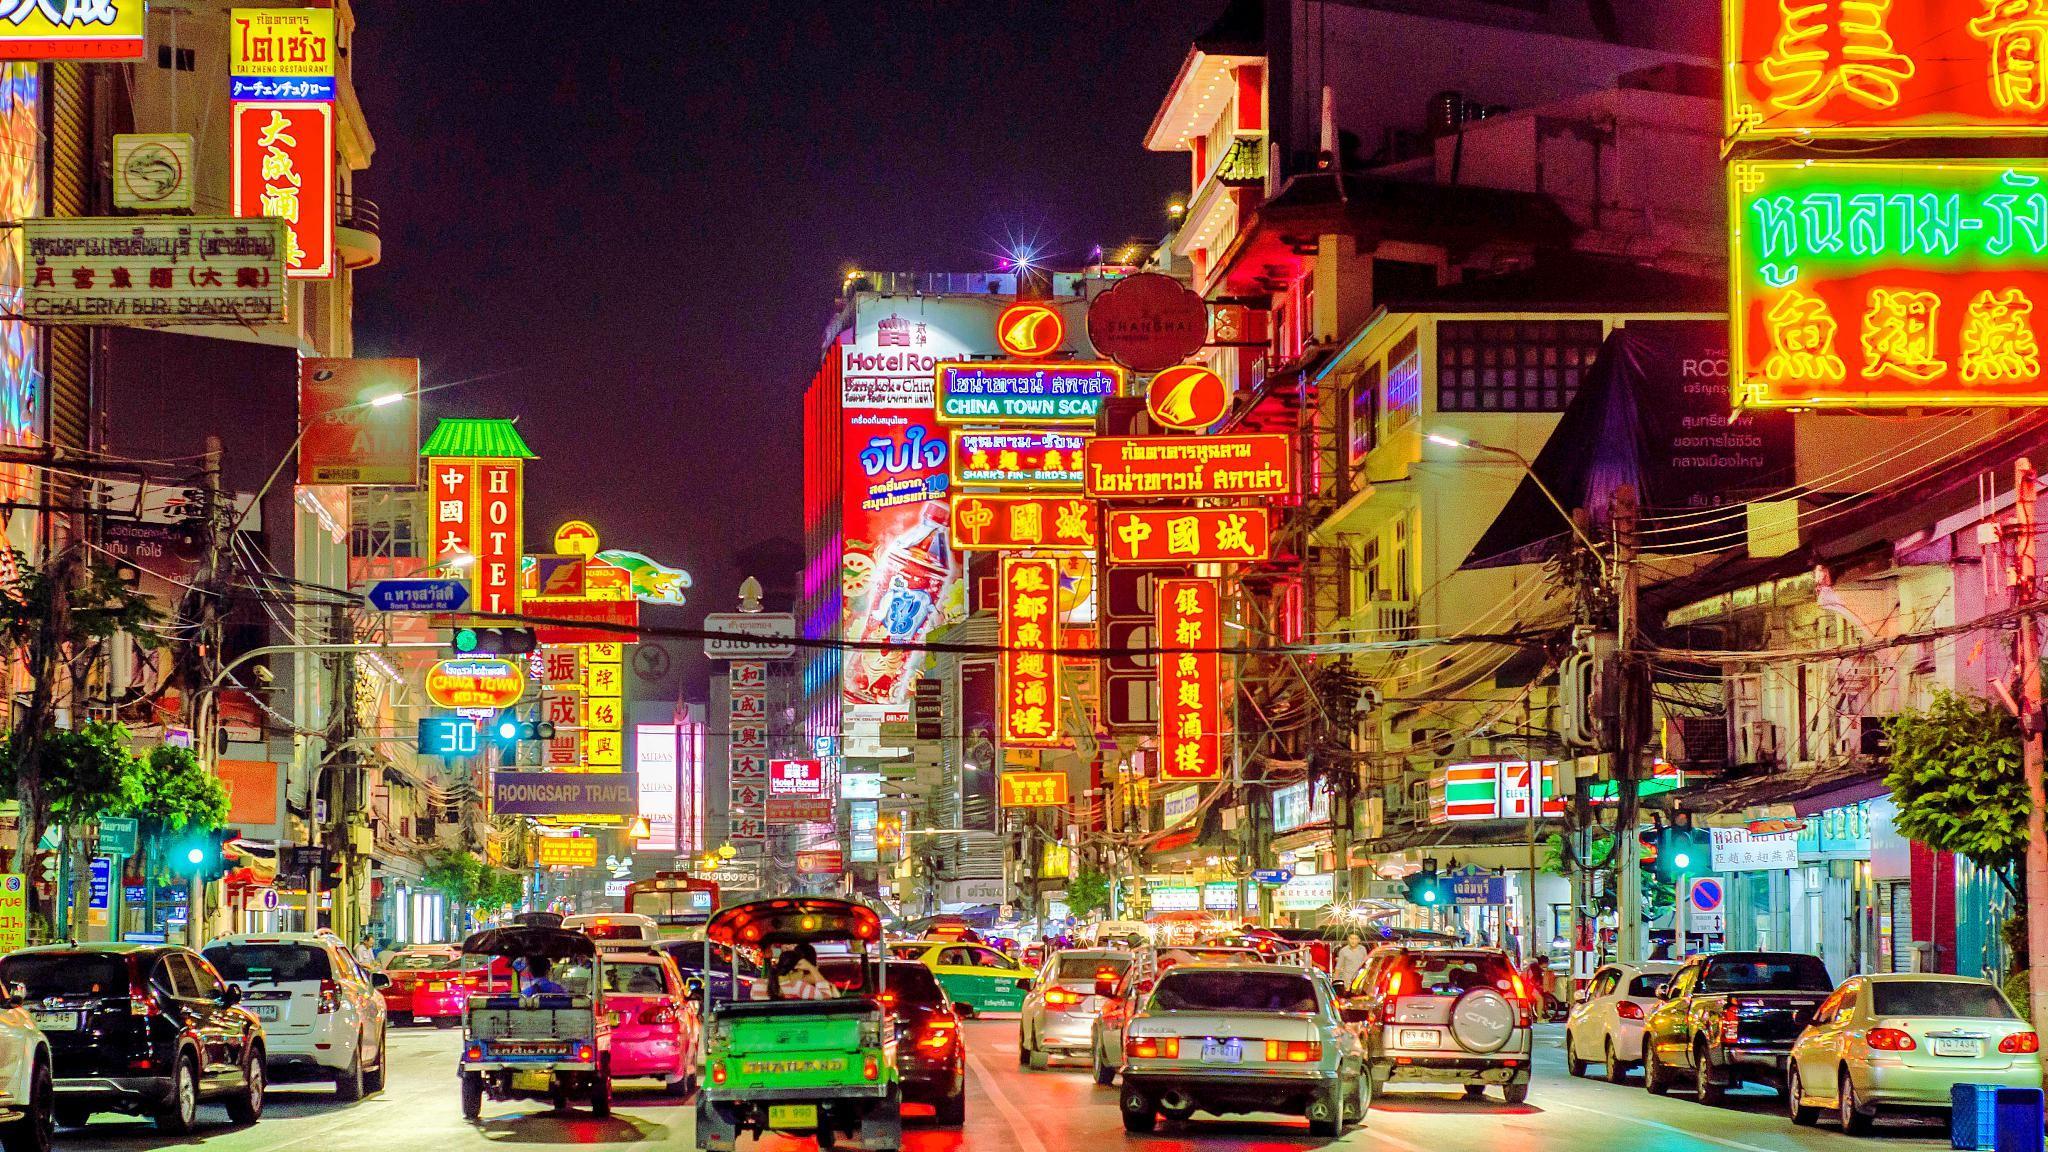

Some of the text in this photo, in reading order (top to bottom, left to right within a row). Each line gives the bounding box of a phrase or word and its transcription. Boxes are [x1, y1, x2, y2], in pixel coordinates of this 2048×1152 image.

[237, 65, 329, 73] TAI ZHENG RESTAURANT
[846, 353, 966, 372] Hotel Rol
[844, 378, 934, 398] Bangkok Chin
[946, 399, 999, 415] CHINA
[1003, 399, 1055, 415] TOWN
[860, 424, 948, 476] จับใจ
[926, 473, 949, 491] 10
[963, 470, 1005, 480] SHARK'S
[1035, 470, 1067, 480] BIRD'S
[960, 499, 1095, 545] 中國城
[488, 470, 509, 614] HOTEL
[1117, 513, 1255, 559] 中國城
[432, 676, 518, 692] CHINA TOWN
[453, 691, 496, 705] HOTEL
[441, 722, 476, 752] 30
[641, 752, 673, 761] MIDAS
[498, 784, 630, 801] ROONGSARP TRAVEL
[641, 783, 673, 791] MIDAS
[742, 1060, 843, 1072] THAILAND
